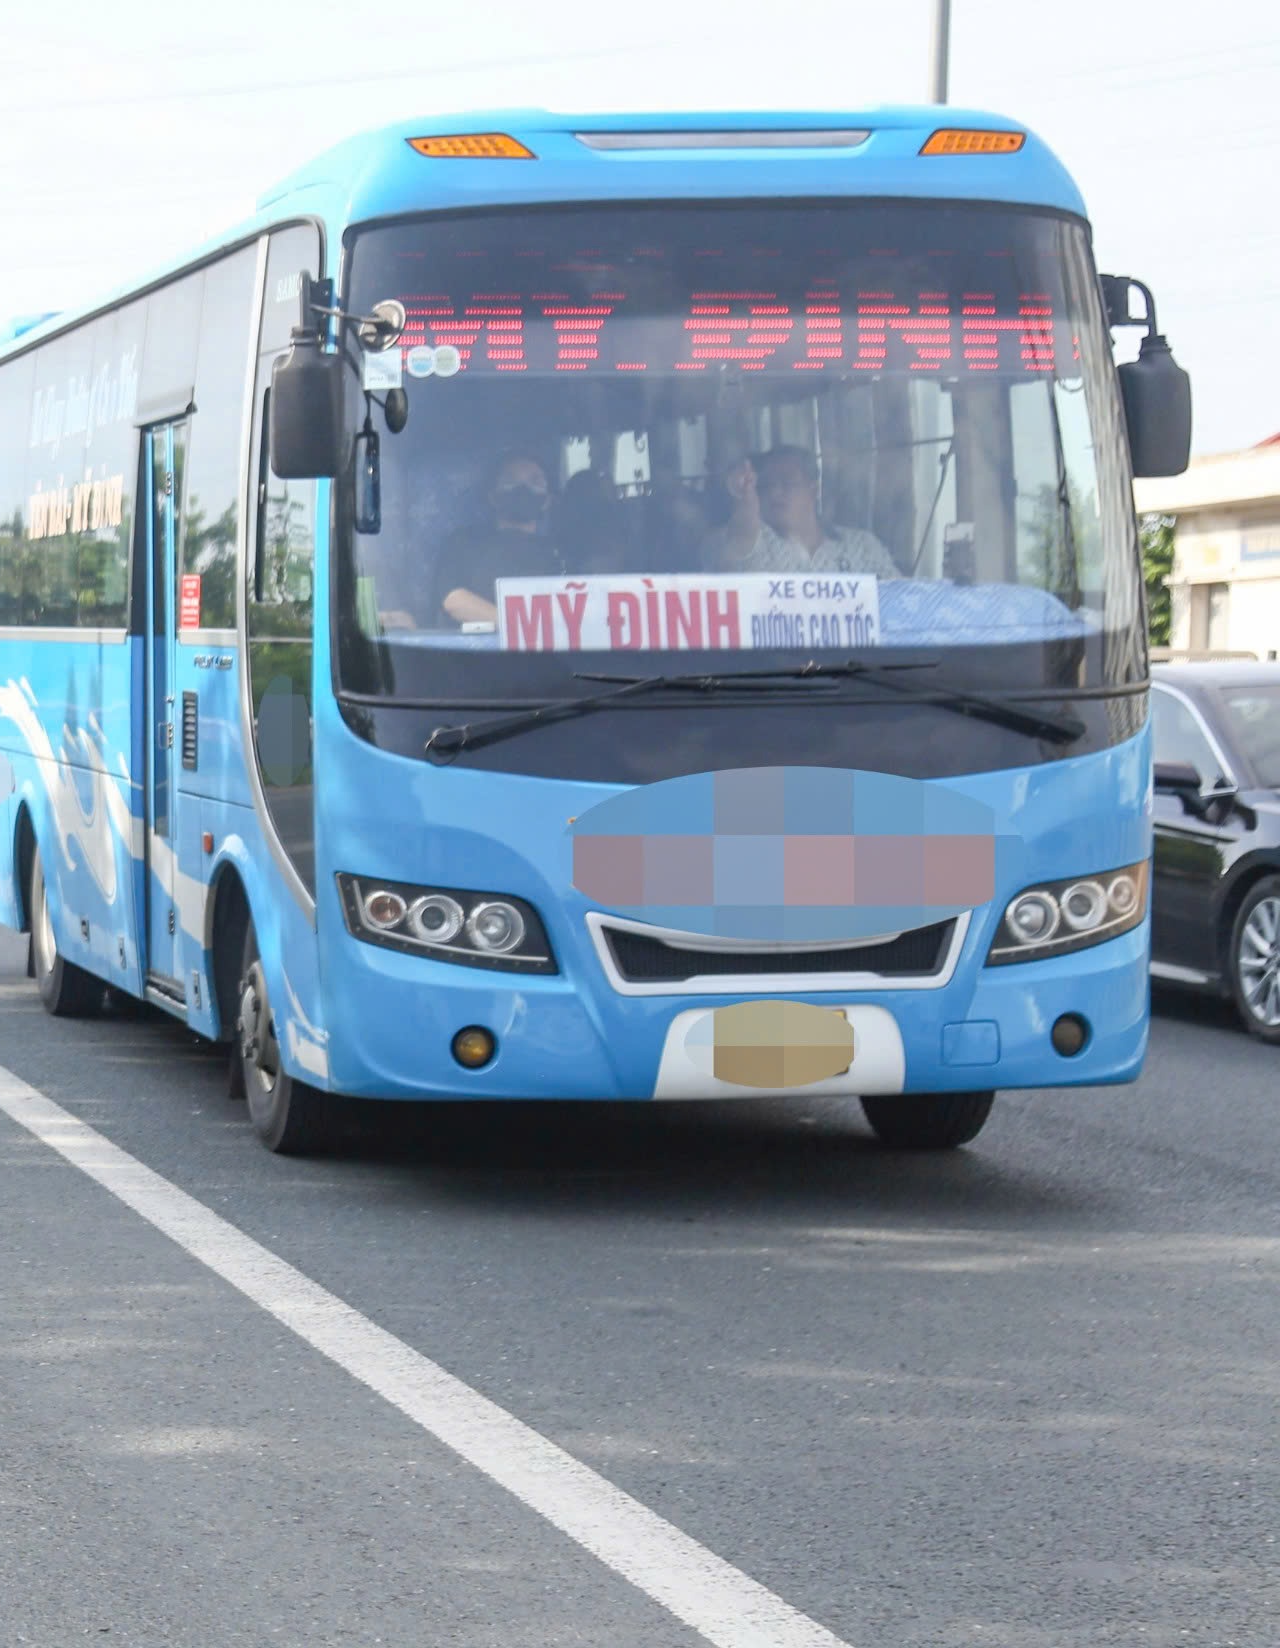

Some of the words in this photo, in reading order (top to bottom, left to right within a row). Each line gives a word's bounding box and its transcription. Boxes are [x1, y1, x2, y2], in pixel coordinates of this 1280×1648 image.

[768, 580, 796, 599] XE
[802, 580, 860, 602] CHẠY
[505, 581, 588, 650] MỸ
[607, 579, 742, 649] ĐÌNH
[809, 614, 841, 648] CAO
[844, 602, 875, 648] TỐC
